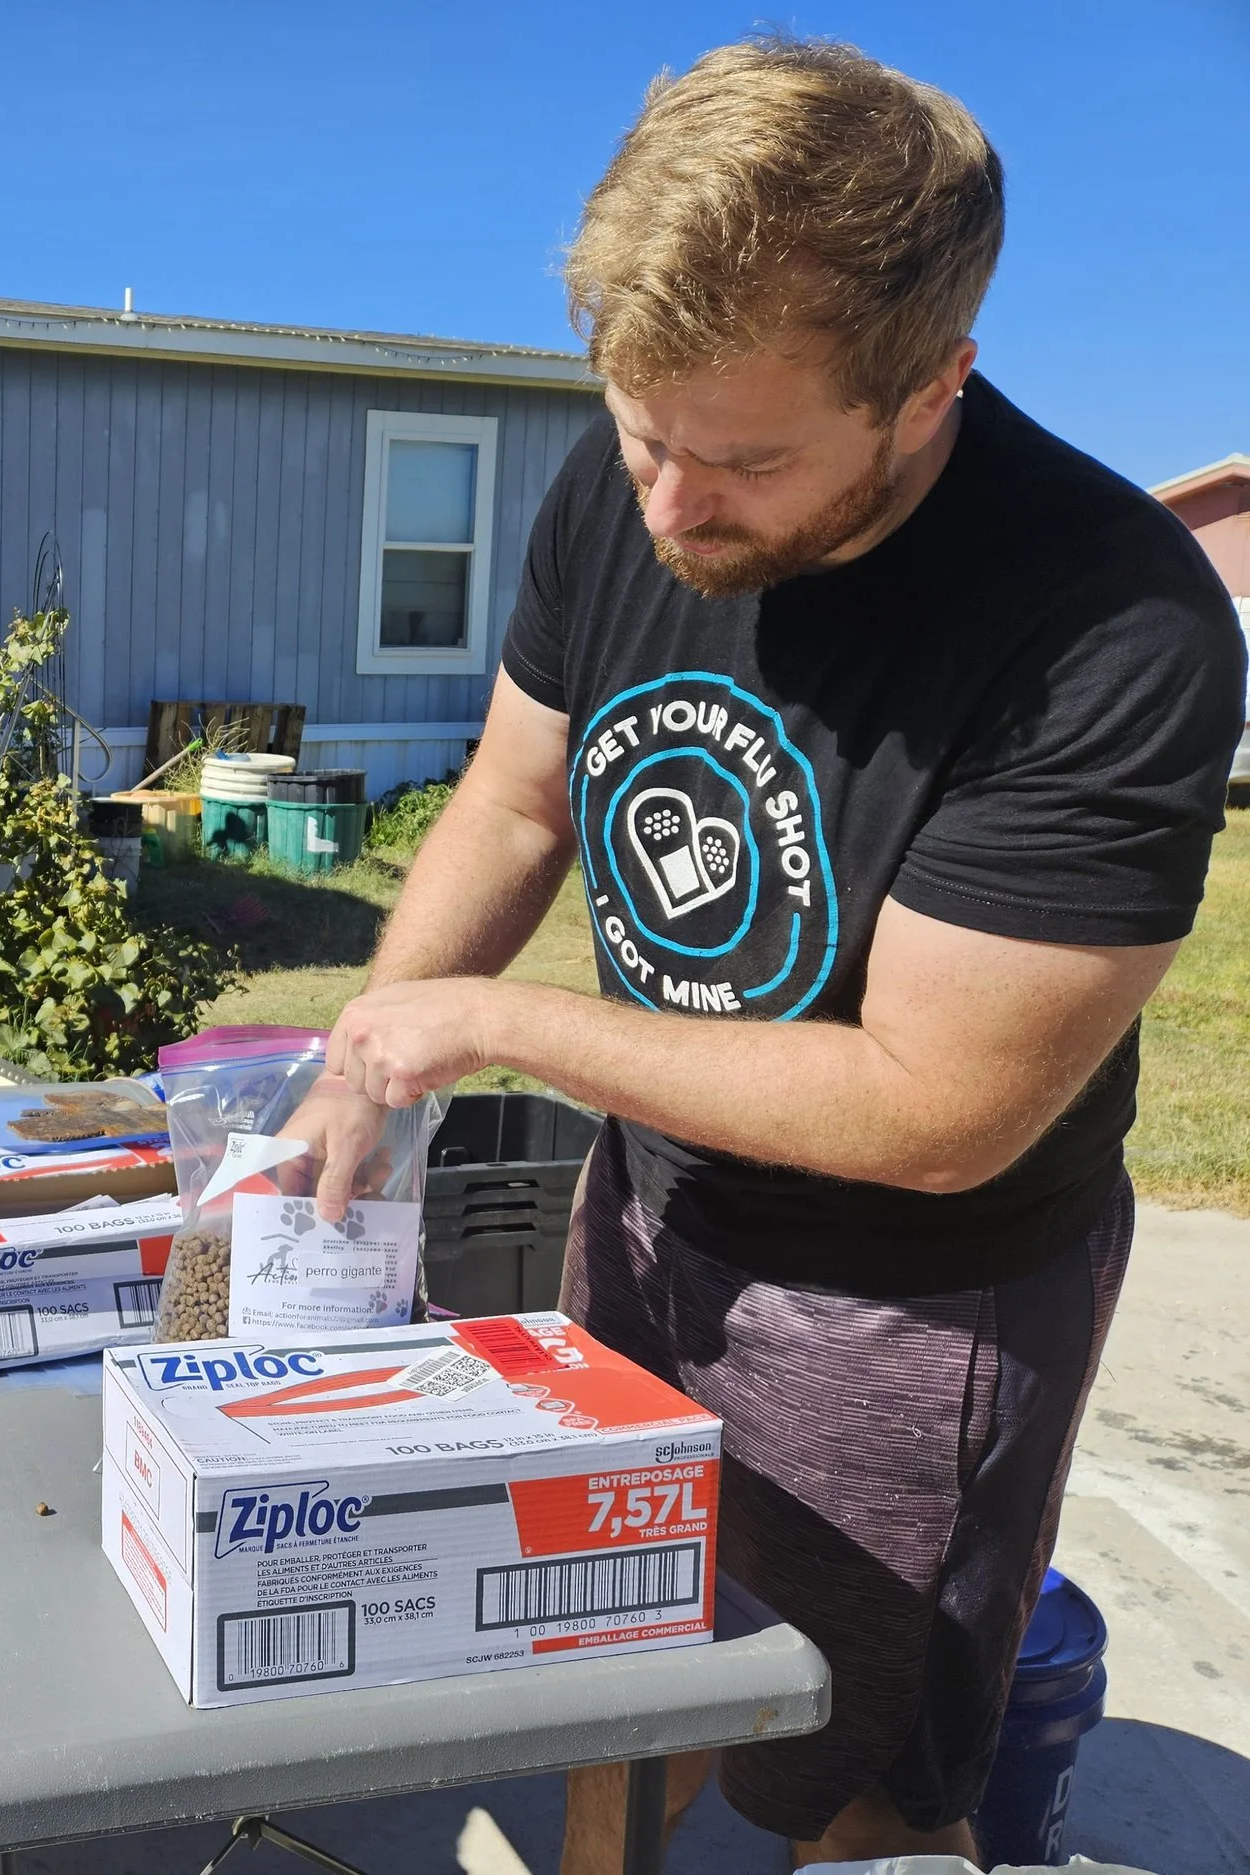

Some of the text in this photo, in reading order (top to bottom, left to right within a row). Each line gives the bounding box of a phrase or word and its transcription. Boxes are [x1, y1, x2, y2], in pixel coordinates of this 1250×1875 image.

[586, 700, 811, 907] GET YOUR FLU SHOT
[596, 894, 742, 1012] I GOT MINE
[54, 1223, 85, 1234] 100
[88, 1217, 135, 1230] BAGS
[305, 1265, 382, 1279] perro gigante
[37, 1302, 89, 1317] 100 SACS
[298, 1304, 321, 1312] more
[150, 1351, 324, 1391] Ziploc
[600, 1413, 713, 1434] COMMERCIAL PACK
[385, 1439, 505, 1456] 100 BAGS
[134, 1448, 152, 1488] BMC
[588, 1465, 704, 1490] ENTREPOSAGE
[588, 1482, 708, 1538] 7,57L
[229, 1491, 362, 1554] Ziploc
[639, 1522, 708, 1538] TRÈS GRAND
[238, 1545, 263, 1553] MARQUE
[276, 1542, 293, 1550] SACS
[299, 1538, 332, 1547] FERMETURE
[333, 1535, 359, 1544] ÉTANCHE
[257, 1543, 427, 1568] POUR EMBALLER, PROTÉGER ET TRANSPORTER
[257, 1569, 271, 1577] LES
[272, 1564, 310, 1575] ALIMENTS
[321, 1560, 357, 1570] D'AUTRES
[358, 1556, 393, 1566] ARTICLES
[257, 1563, 423, 1587] FABRIQUÉS CONFORMÉMENT AUX EXIGENCES
[257, 1589, 268, 1597] DE
[269, 1588, 279, 1596] LA
[280, 1586, 296, 1594] FDA
[297, 1584, 318, 1592] POUR
[330, 1578, 365, 1589] CONTACT
[366, 1576, 387, 1584] AVEC
[387, 1574, 401, 1582] LES
[401, 1570, 438, 1581] ALIMENTS
[257, 1591, 353, 1608] ÉTIQUETTE D'INSCRIPTION
[361, 1596, 436, 1617] 100 SACS
[364, 1616, 382, 1626] 33,0
[383, 1615, 397, 1623] cm
[404, 1612, 420, 1621] 38,1
[514, 1609, 663, 1639] 1 00 19800 70760 3
[578, 1621, 707, 1647] EMBALLAGE COMMERCIAL
[466, 1650, 524, 1664] SCJW 682253
[228, 1673, 234, 1681] 0
[250, 1665, 284, 1678] 19800
[289, 1660, 324, 1674] 70760
